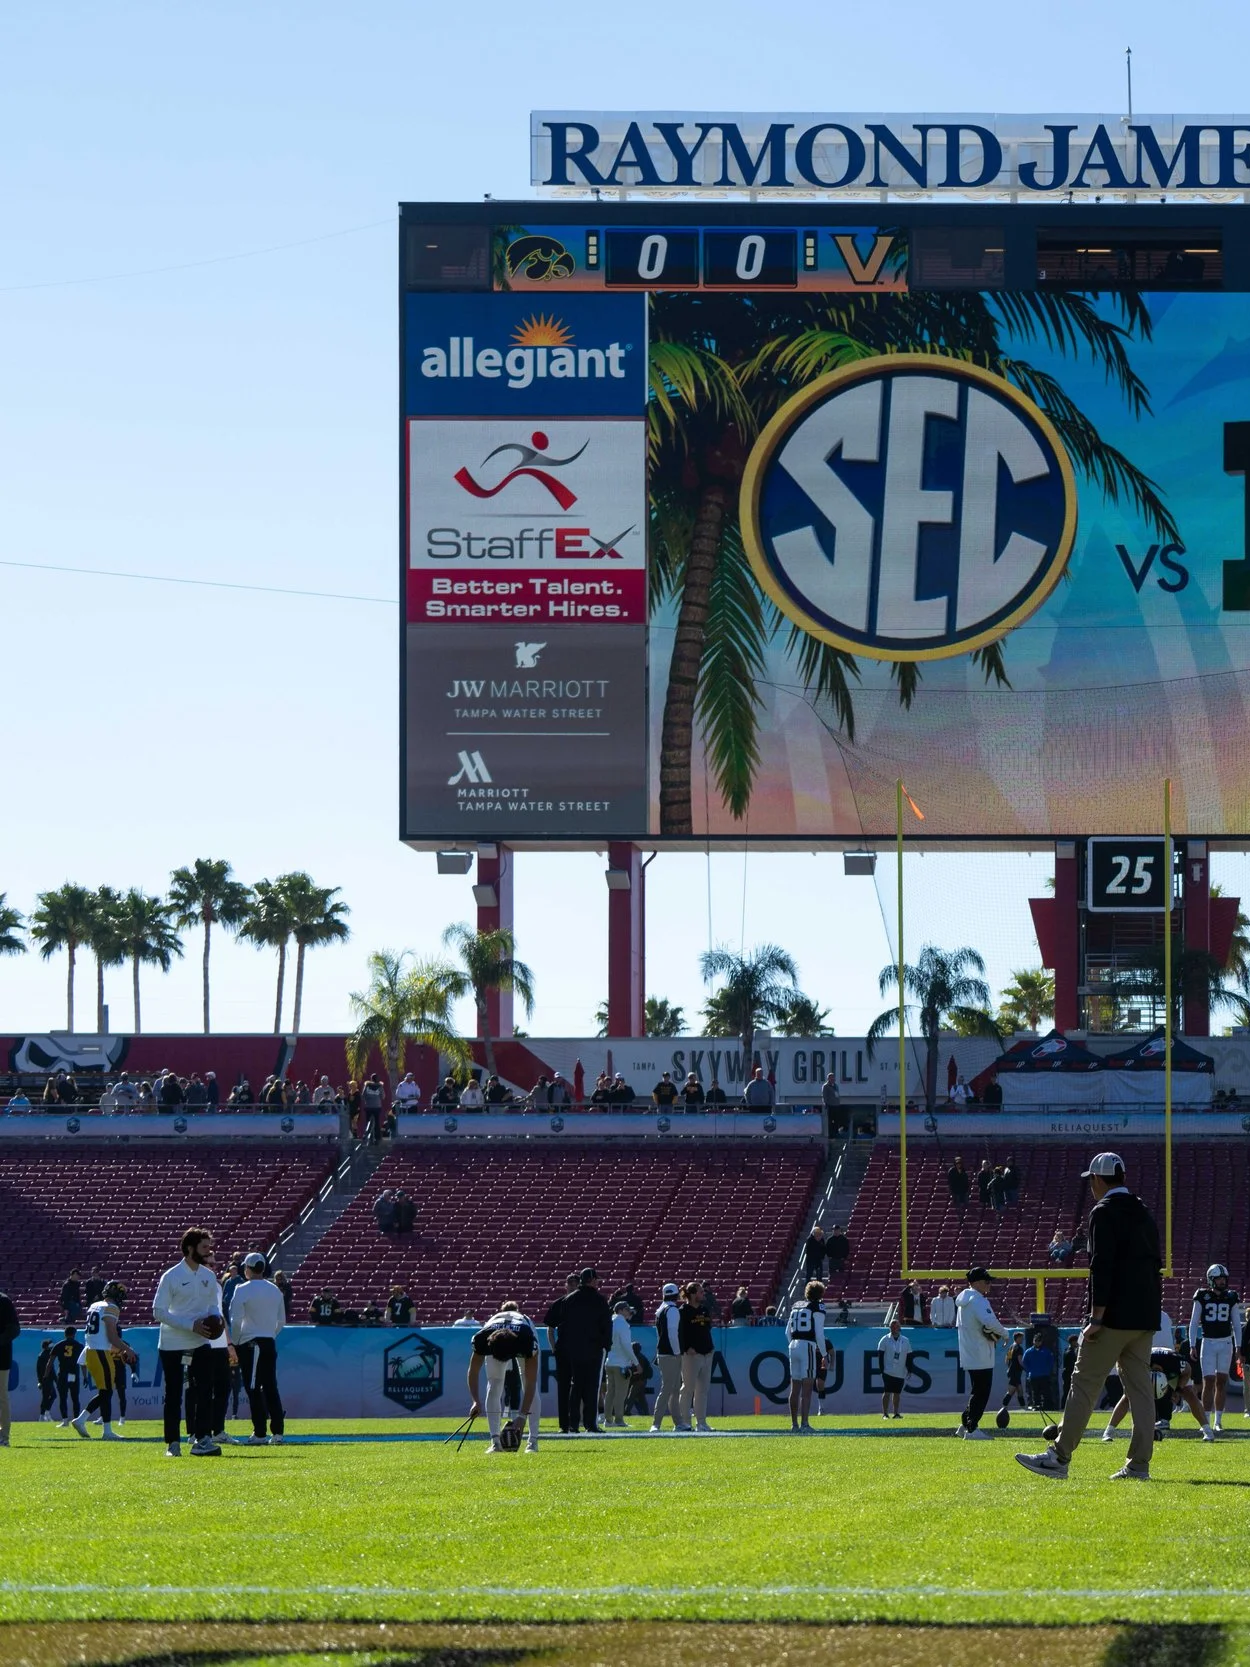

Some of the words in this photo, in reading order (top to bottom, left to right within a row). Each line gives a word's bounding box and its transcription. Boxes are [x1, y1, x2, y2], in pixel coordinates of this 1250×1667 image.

[542, 121, 1003, 189] RAYMOND
[638, 234, 669, 280] 0
[735, 234, 766, 280] 0
[421, 336, 626, 389] allegiant
[771, 375, 1050, 640] SEC
[1115, 544, 1190, 593] VS
[432, 578, 523, 595] Better
[529, 578, 622, 595] Talent.
[426, 600, 541, 617] Smarter
[549, 600, 629, 617] Hires.
[446, 680, 486, 698] JW
[490, 680, 609, 698] MARRIOTT
[455, 709, 497, 718] TAMPA
[502, 709, 546, 718] WATER
[552, 709, 602, 718] STREET
[457, 788, 529, 798] MARRIOTT
[457, 802, 502, 811] TAMPA
[508, 802, 552, 811] WATER
[559, 802, 610, 811] STREET
[1105, 855, 1155, 894] 25
[632, 1062, 656, 1071] TAMPA
[671, 1050, 780, 1084] SKYWAY
[793, 1050, 868, 1084] GRILL
[1051, 1123, 1120, 1133] RELIAQUEST
[320, 1304, 332, 1316] 16
[1205, 1303, 1230, 1322] 38
